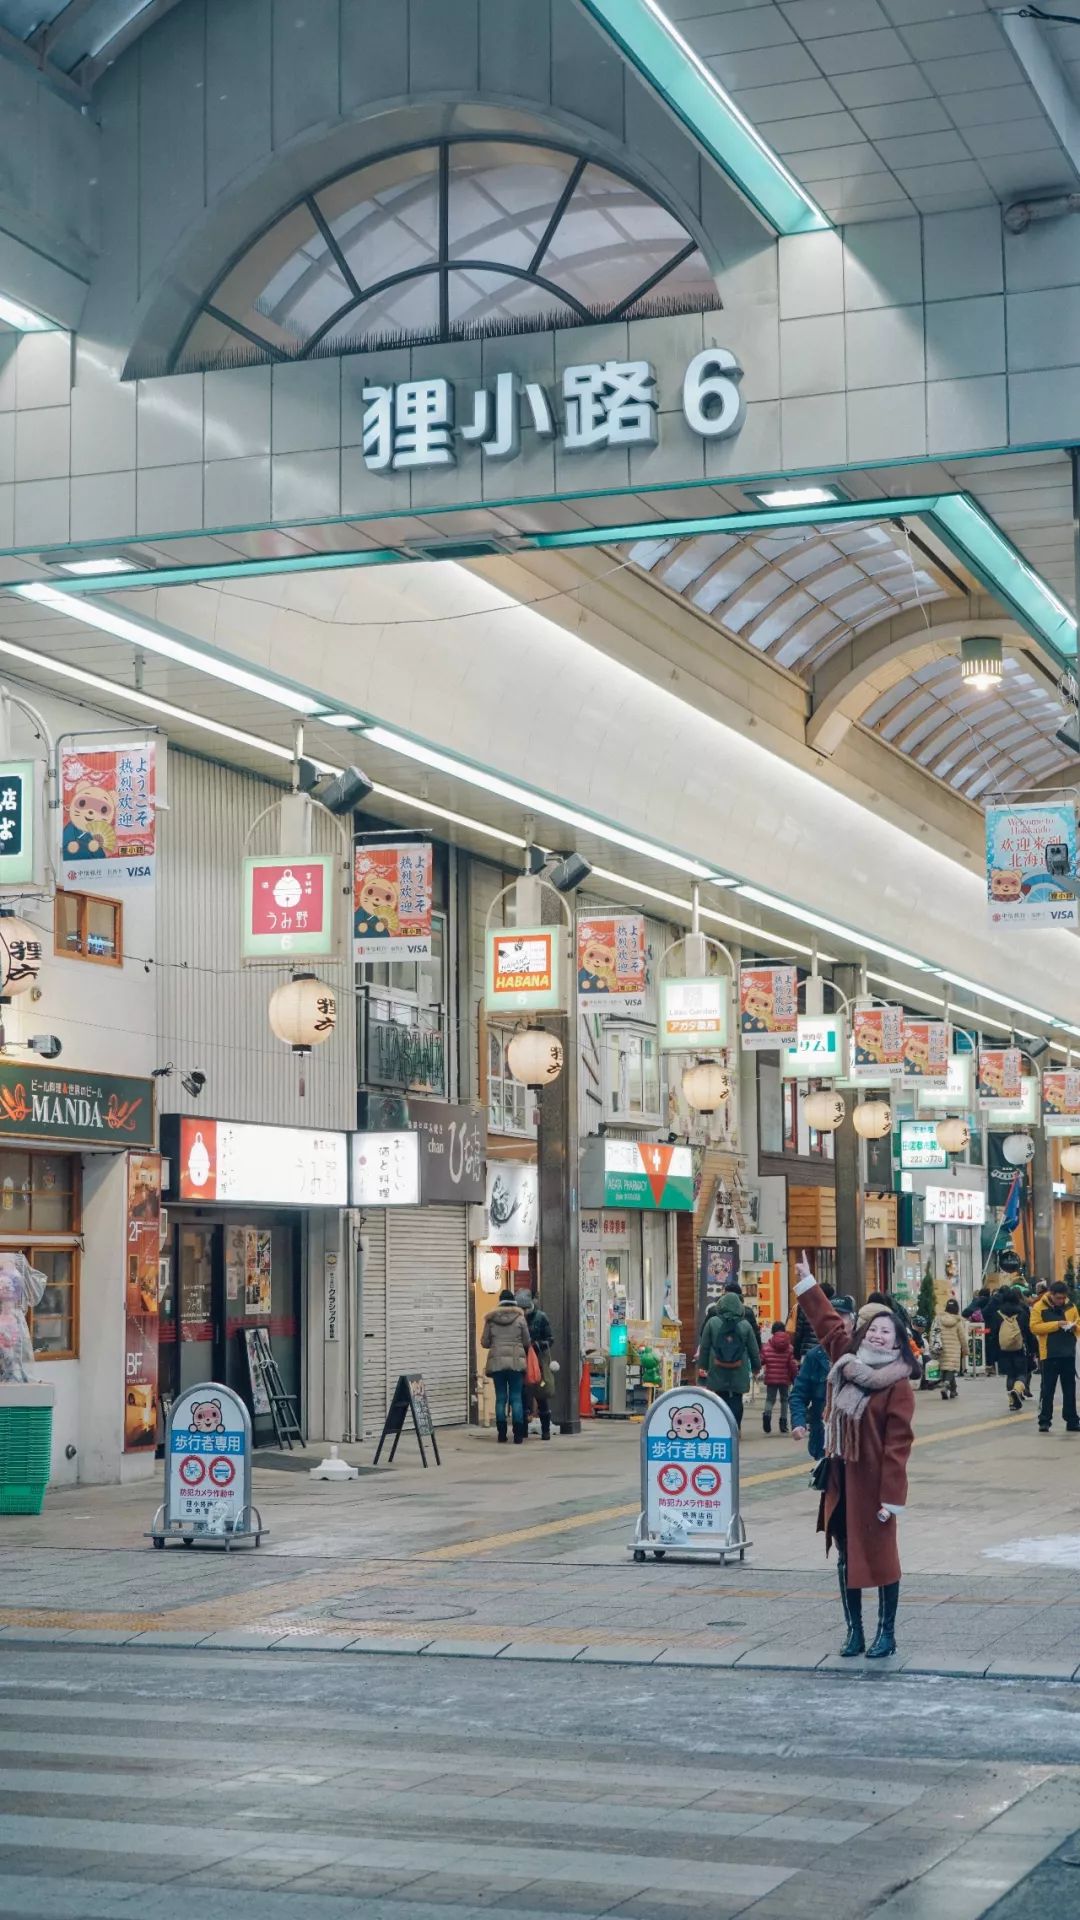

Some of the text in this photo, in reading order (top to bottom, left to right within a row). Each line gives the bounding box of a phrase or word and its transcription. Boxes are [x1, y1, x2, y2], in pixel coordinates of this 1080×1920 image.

[362, 347, 744, 474] 狸小路 6
[117, 758, 134, 829] 热烈欢迎
[134, 756, 148, 829] ようこそ
[126, 866, 152, 878] VISA
[399, 856, 413, 913] 热烈欢迎
[415, 856, 425, 913] ようこそ
[266, 911, 309, 930] うみ野
[1051, 910, 1074, 920] VISA
[407, 945, 428, 954] VISA
[616, 925, 629, 974] 热烈欢迎
[629, 925, 639, 974] ようこそ
[496, 974, 550, 989] HABANA
[624, 999, 643, 1007] VISA
[784, 974, 794, 1015] ようこそ
[31, 1094, 104, 1128] MANDA
[428, 1137, 444, 1153] chan
[378, 1146, 391, 1198] 酒と料理
[129, 1221, 143, 1242] 2F
[126, 1353, 143, 1377] BF
[175, 1435, 241, 1453] 歩行者専用
[652, 1442, 728, 1461] 歩行者専用
[180, 1488, 235, 1499] 防犯カメラ作動中
[658, 1497, 721, 1509] 防犯カメラ作動中
